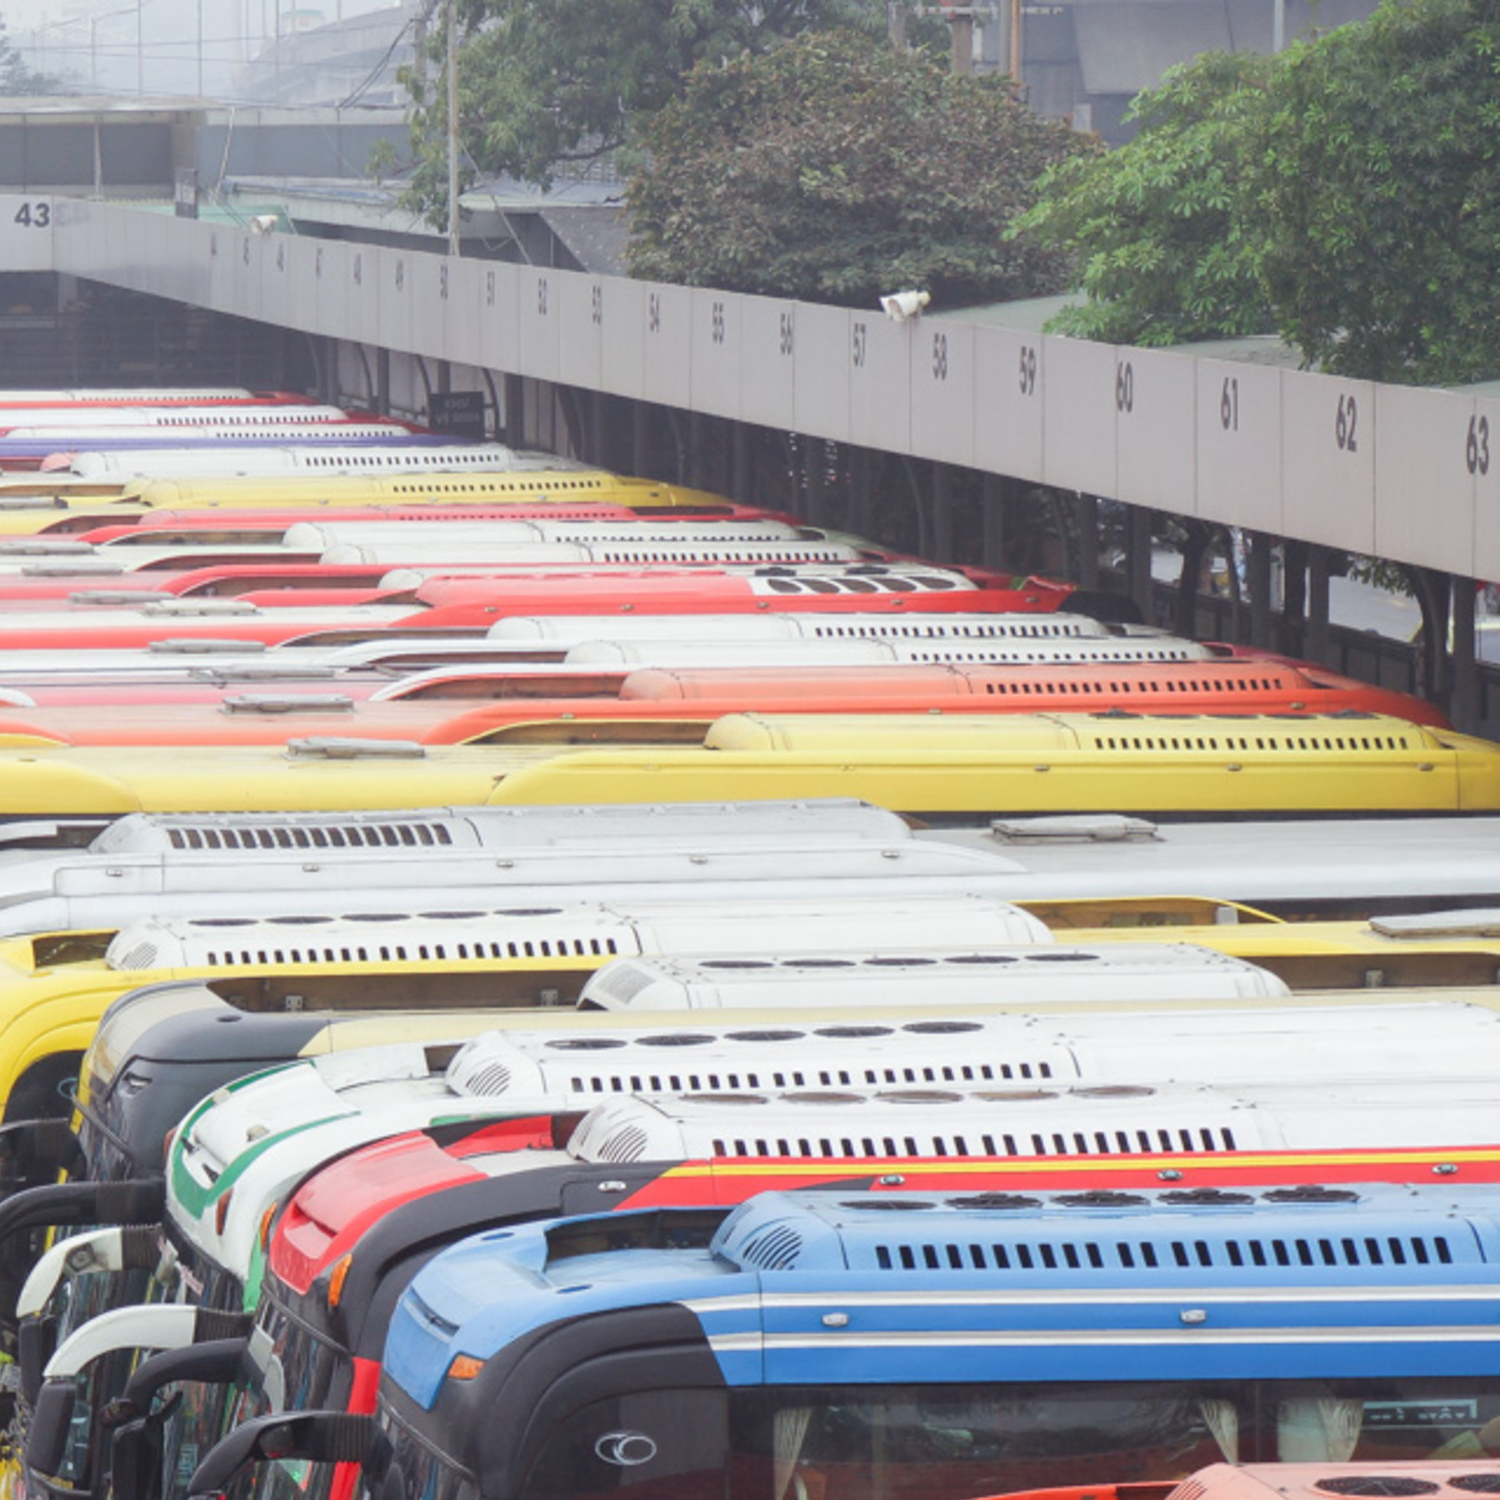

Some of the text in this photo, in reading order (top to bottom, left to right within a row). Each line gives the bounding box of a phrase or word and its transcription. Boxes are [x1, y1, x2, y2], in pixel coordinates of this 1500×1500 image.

[14, 202, 50, 227] 43
[650, 292, 660, 333] 54
[712, 301, 725, 345] 55
[780, 312, 793, 356] 56
[853, 322, 867, 368] 57
[933, 332, 948, 381] 58
[1019, 346, 1037, 397] 59
[1115, 361, 1134, 414] 60
[1220, 376, 1240, 432] 61
[1334, 393, 1358, 453] 62
[1465, 413, 1490, 476] 63
